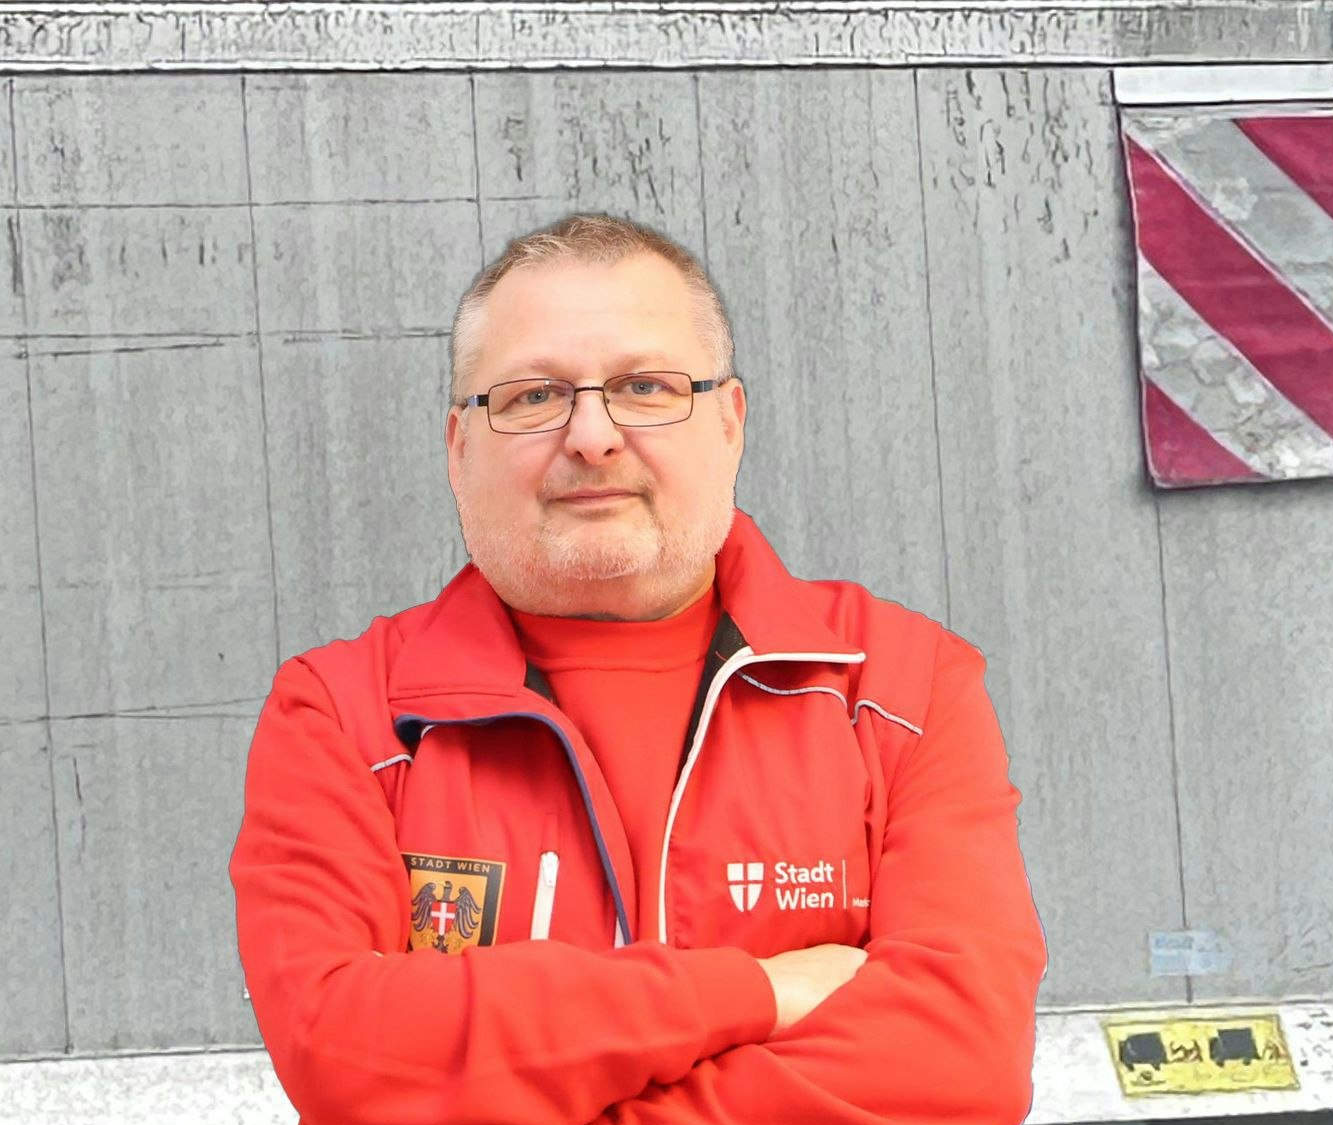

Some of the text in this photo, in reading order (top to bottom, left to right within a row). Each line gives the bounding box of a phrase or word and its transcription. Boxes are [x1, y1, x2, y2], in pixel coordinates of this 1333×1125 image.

[410, 857, 491, 873] STADT WIEN
[774, 860, 835, 884] Stadt
[775, 887, 835, 910] Wien
